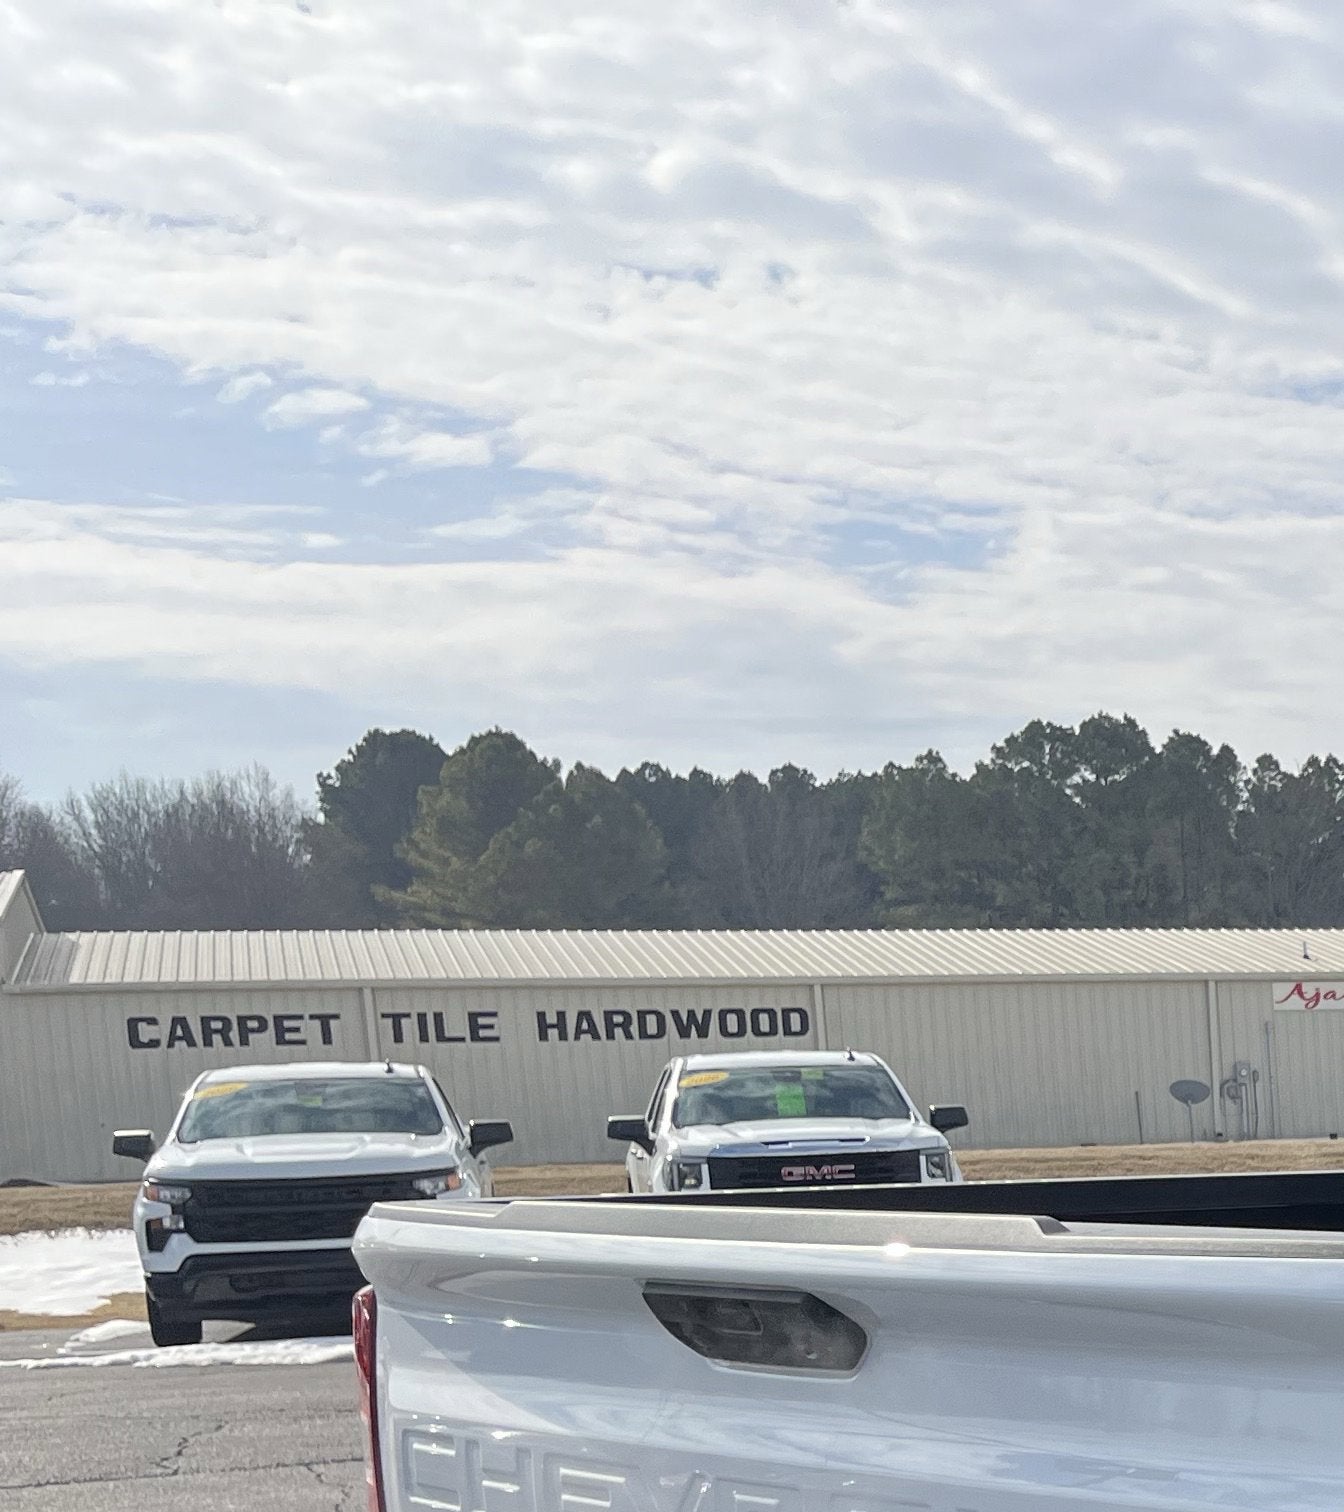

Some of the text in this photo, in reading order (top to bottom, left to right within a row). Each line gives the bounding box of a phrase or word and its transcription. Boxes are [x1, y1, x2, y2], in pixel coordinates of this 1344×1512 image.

[127, 1007, 810, 1050] CARPET TILE HARDWOOD
[781, 1164, 856, 1182] GMC
